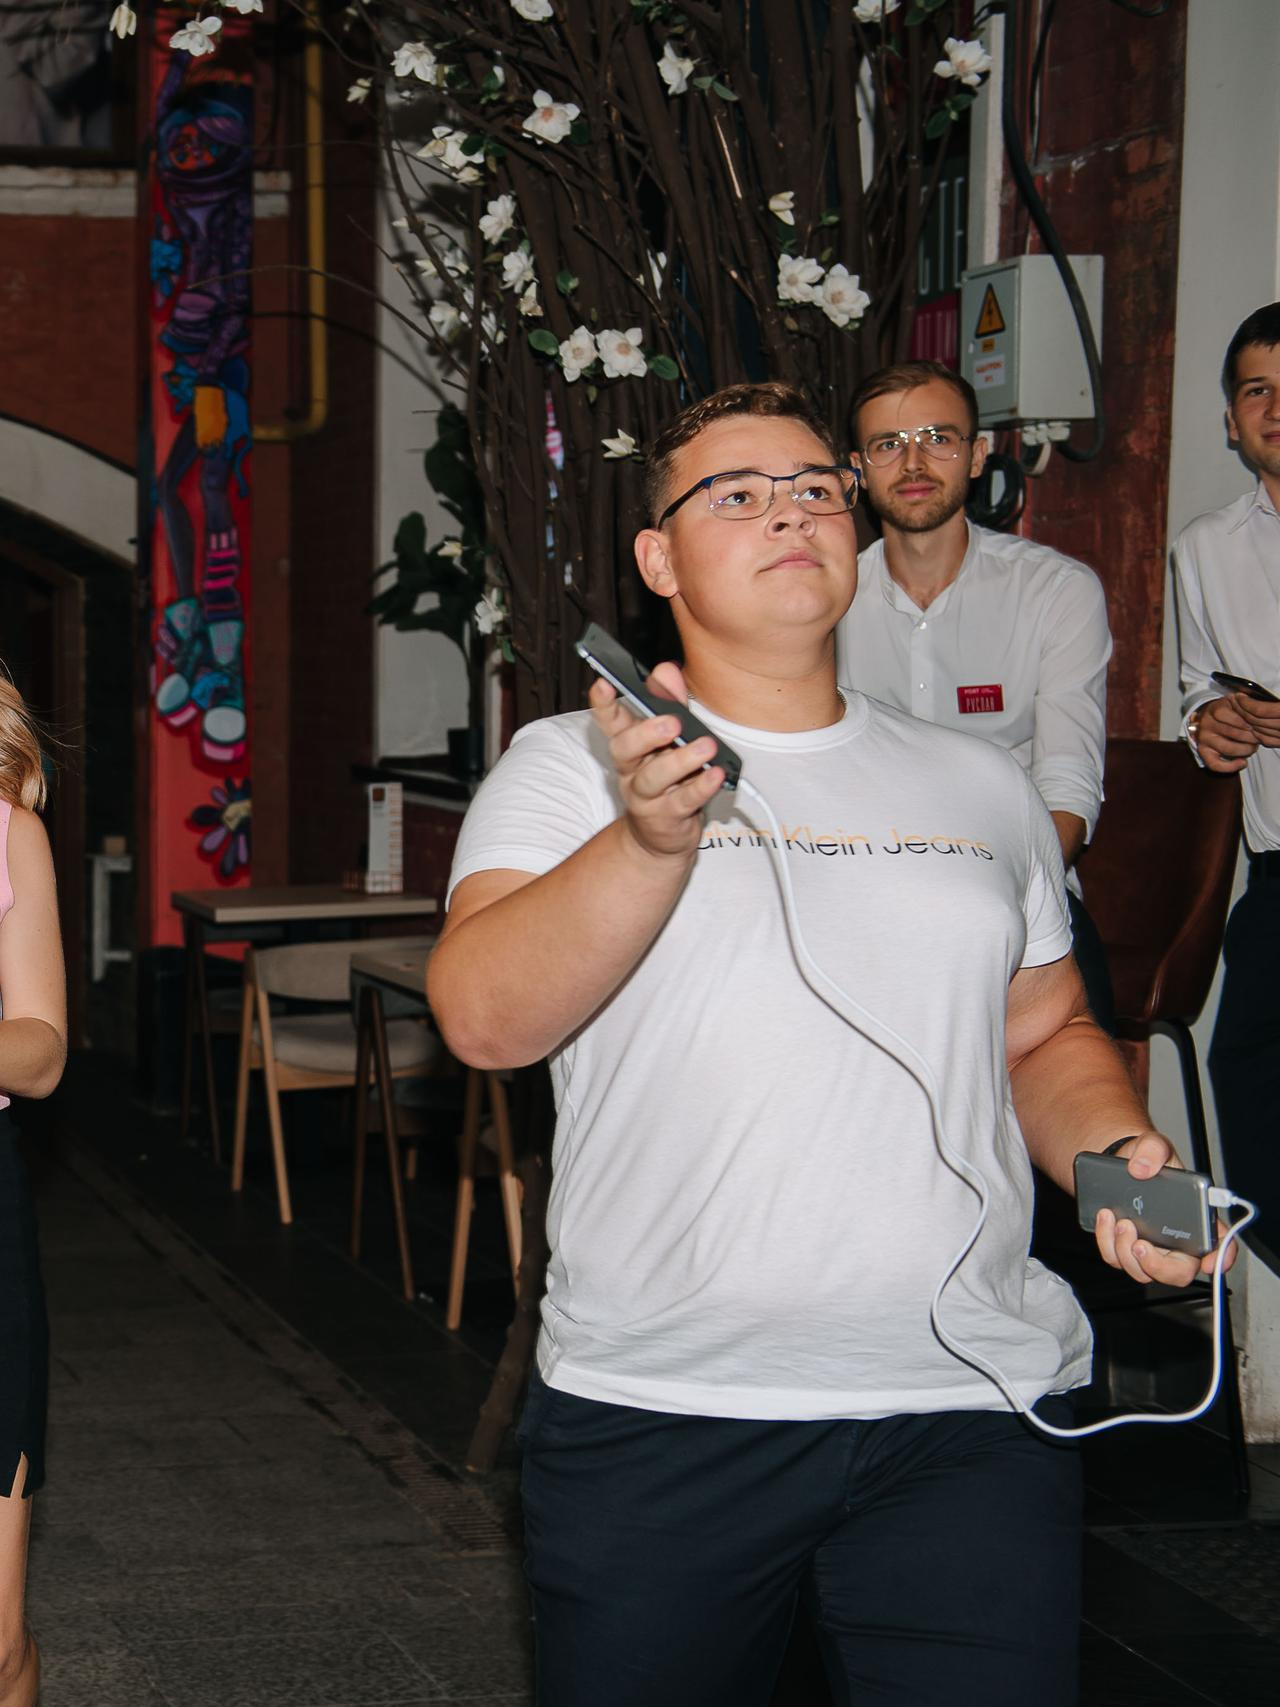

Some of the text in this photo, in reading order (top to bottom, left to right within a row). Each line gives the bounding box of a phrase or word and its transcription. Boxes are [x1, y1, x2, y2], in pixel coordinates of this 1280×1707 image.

[697, 821, 993, 861] alvin Klein Jeans
